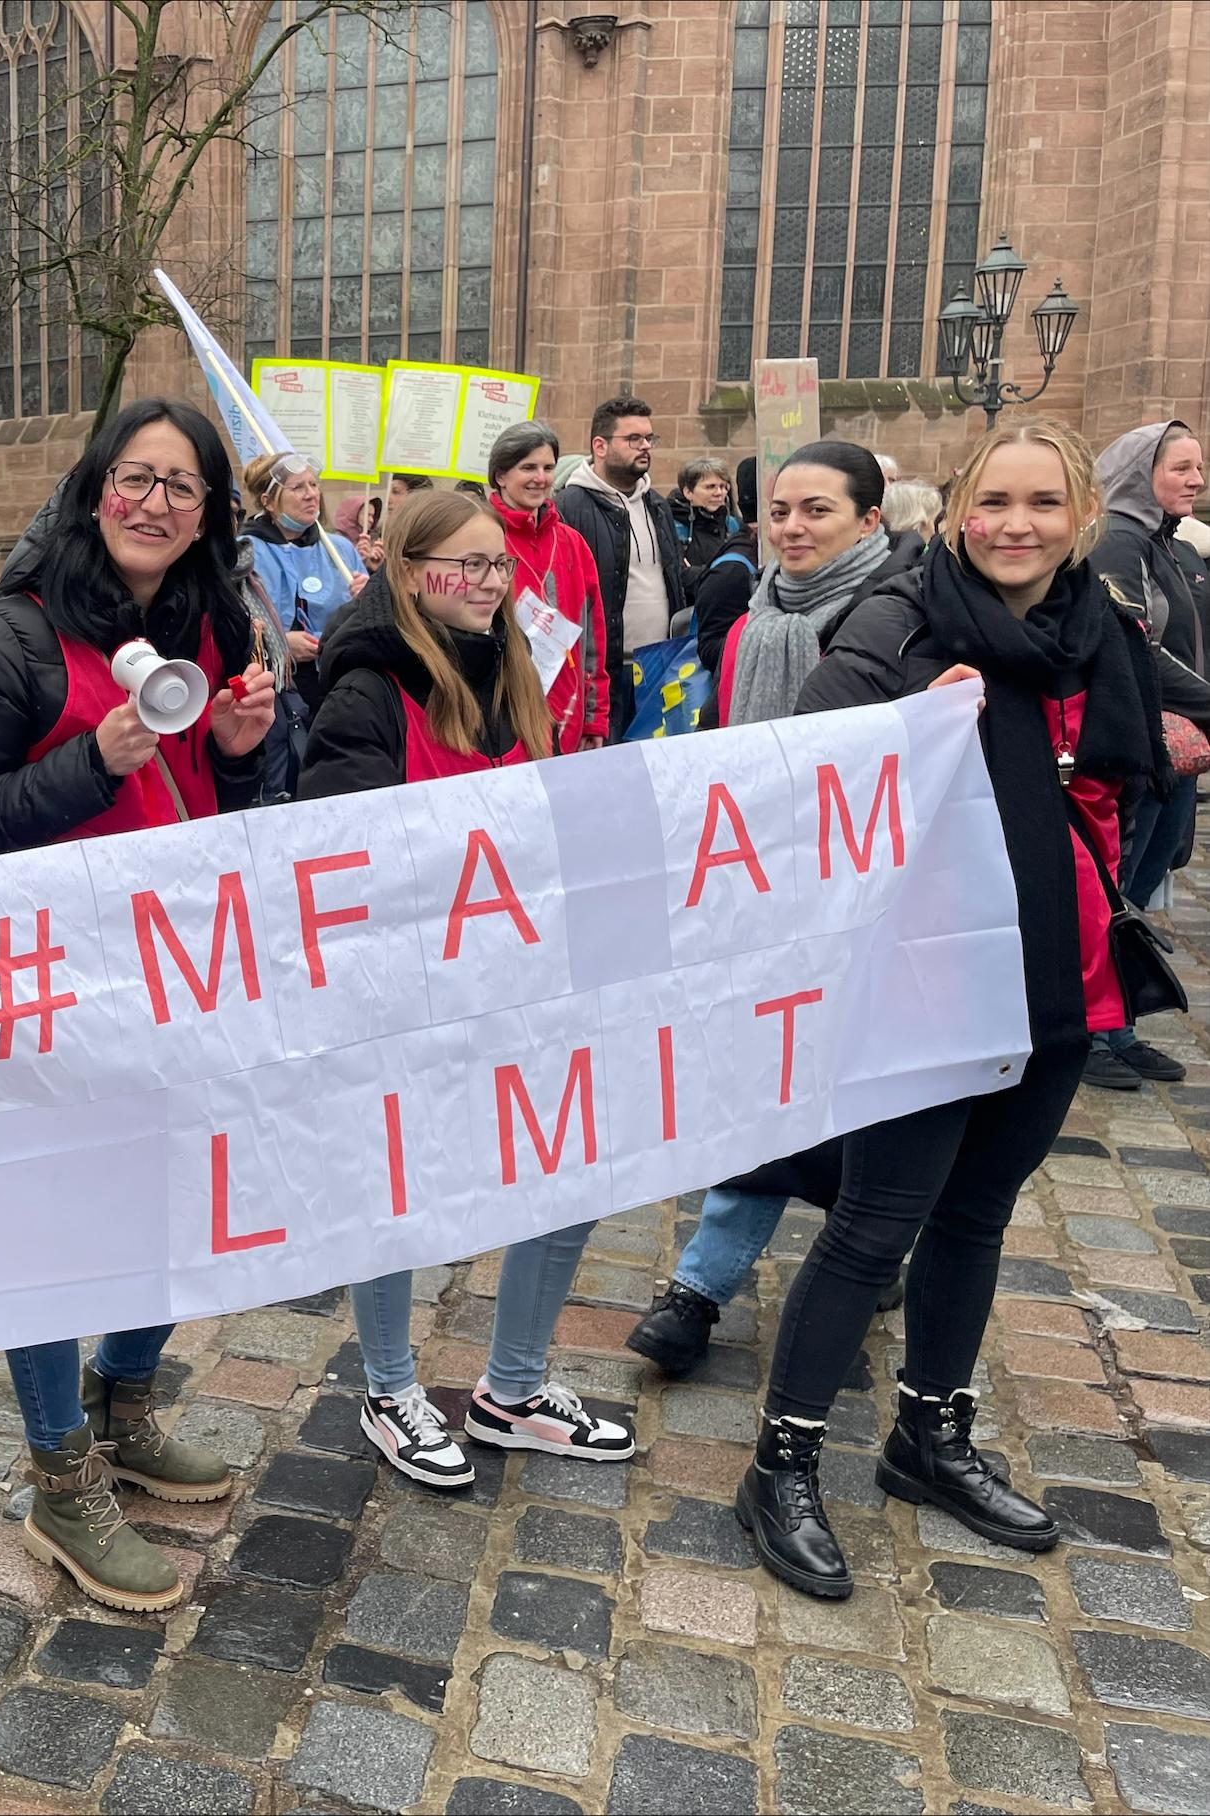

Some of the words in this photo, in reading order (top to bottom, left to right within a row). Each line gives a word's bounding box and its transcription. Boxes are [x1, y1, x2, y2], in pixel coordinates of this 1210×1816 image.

[781, 401, 803, 429] und
[426, 570, 469, 597] MFA
[686, 754, 905, 907] AM
[212, 989, 823, 1255] LIMIT
